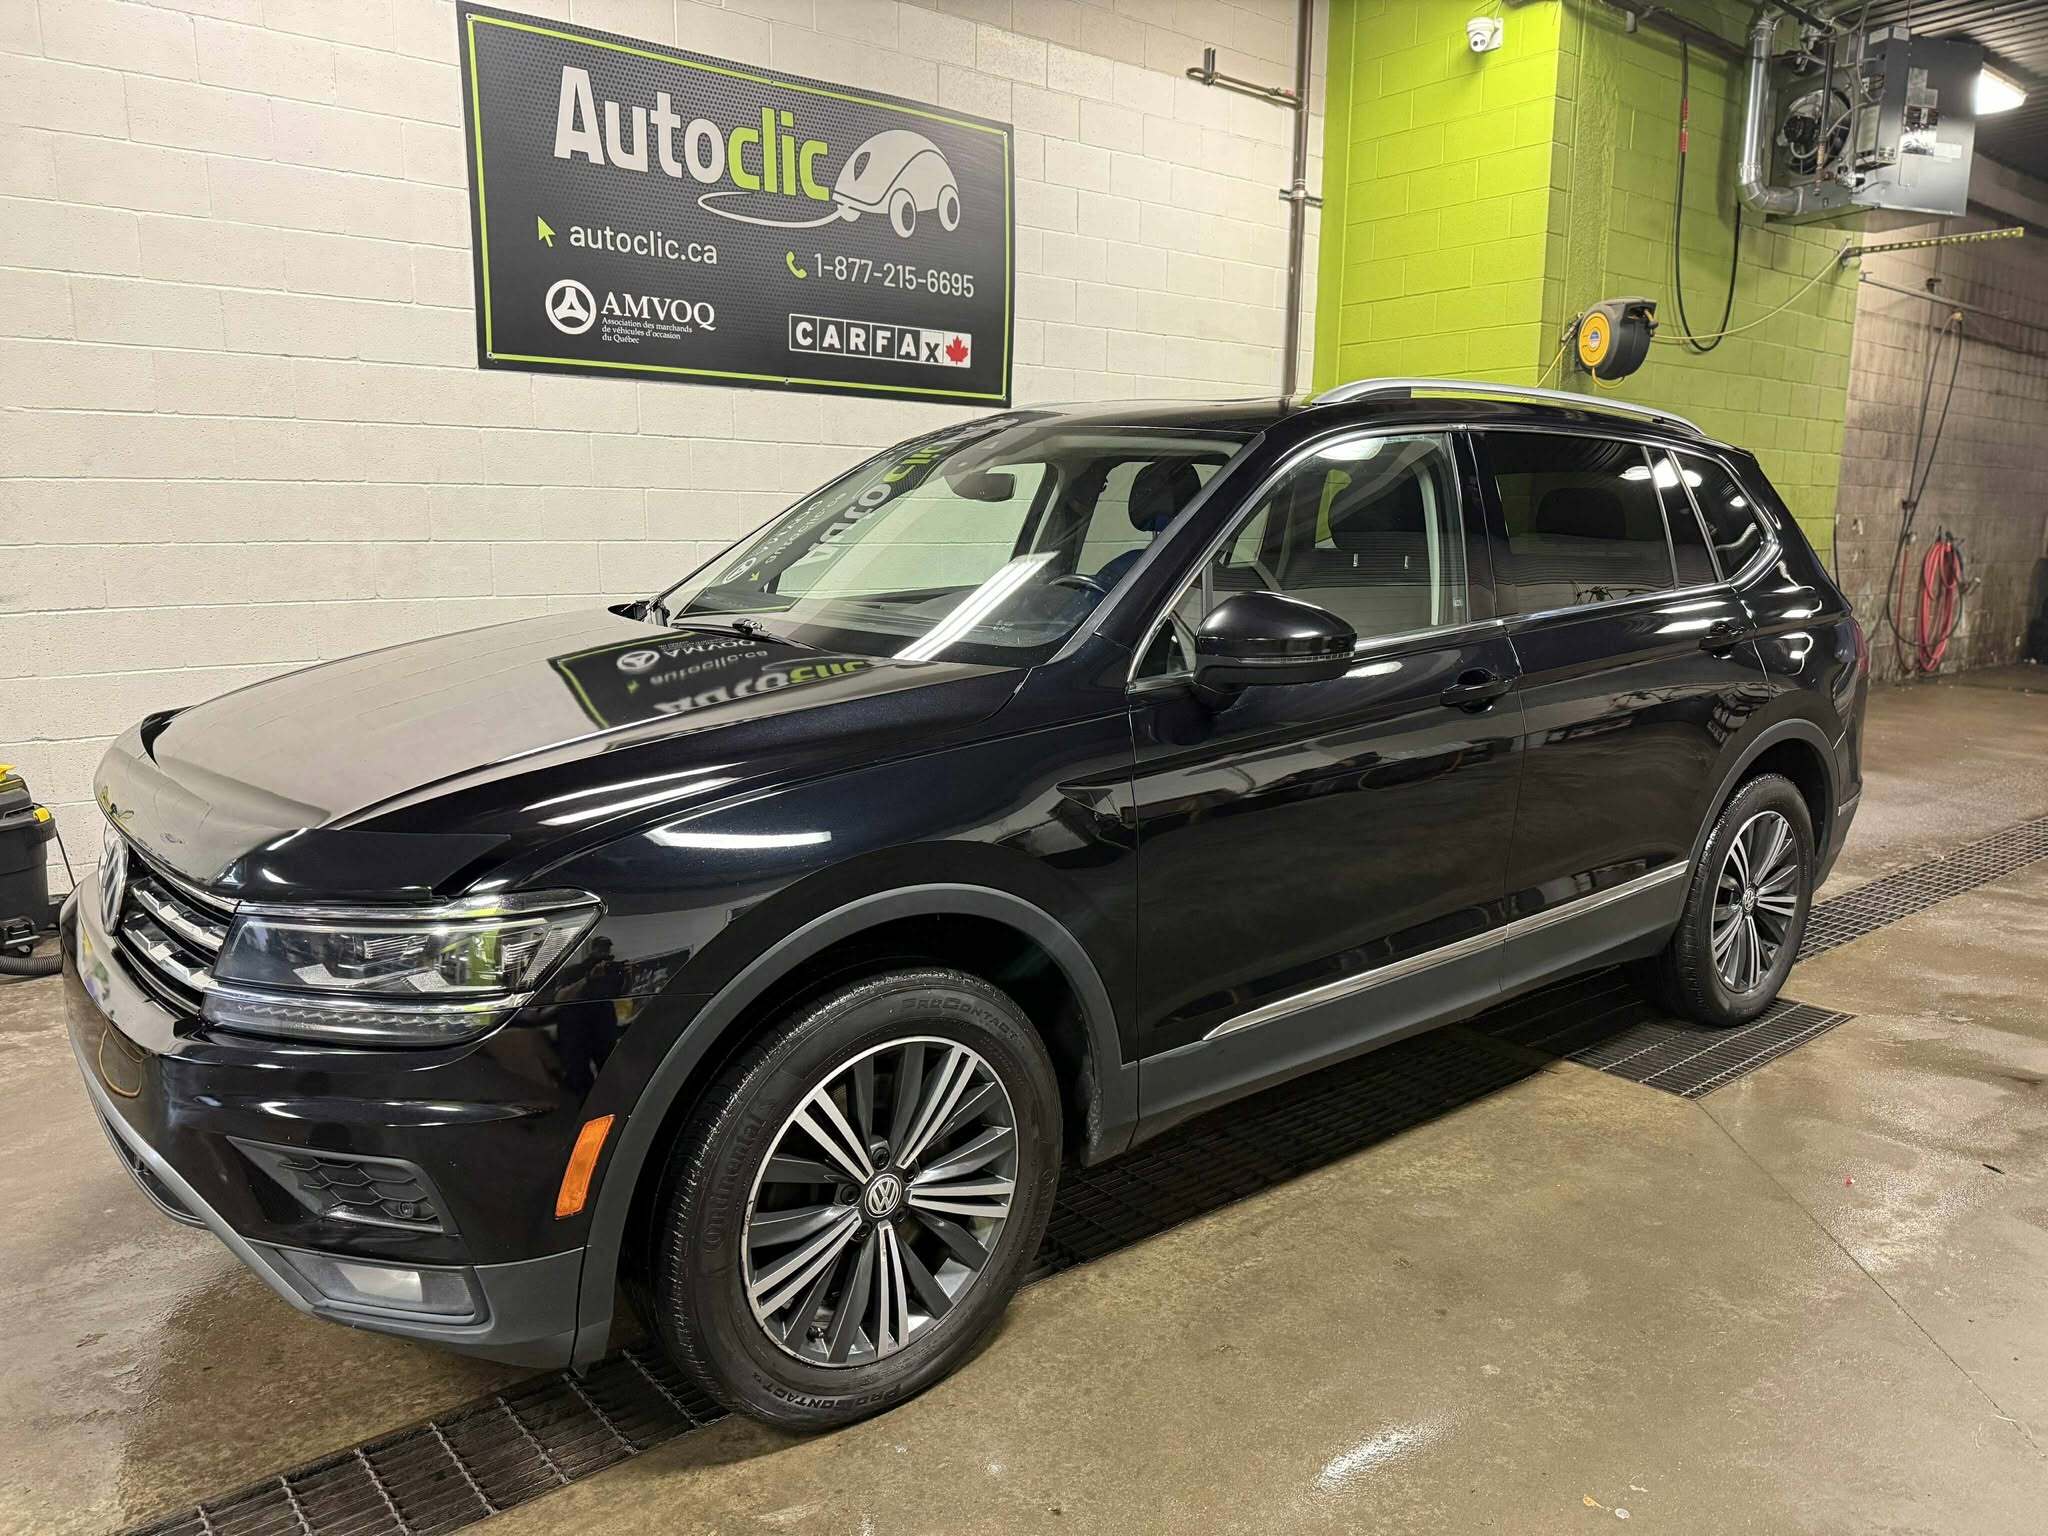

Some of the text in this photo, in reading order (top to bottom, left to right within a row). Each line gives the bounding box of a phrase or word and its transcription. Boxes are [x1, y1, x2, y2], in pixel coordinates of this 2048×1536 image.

[553, 65, 830, 201] Autoclic
[569, 225, 718, 264] autoclic.ca
[814, 253, 975, 298] 1-877-215-6695
[601, 291, 717, 331] AMVOQ
[602, 317, 693, 333] Association des marchands
[602, 325, 681, 340] de véhicules d'occasion
[602, 333, 640, 344] du Québec
[796, 321, 941, 363] CARFAX
